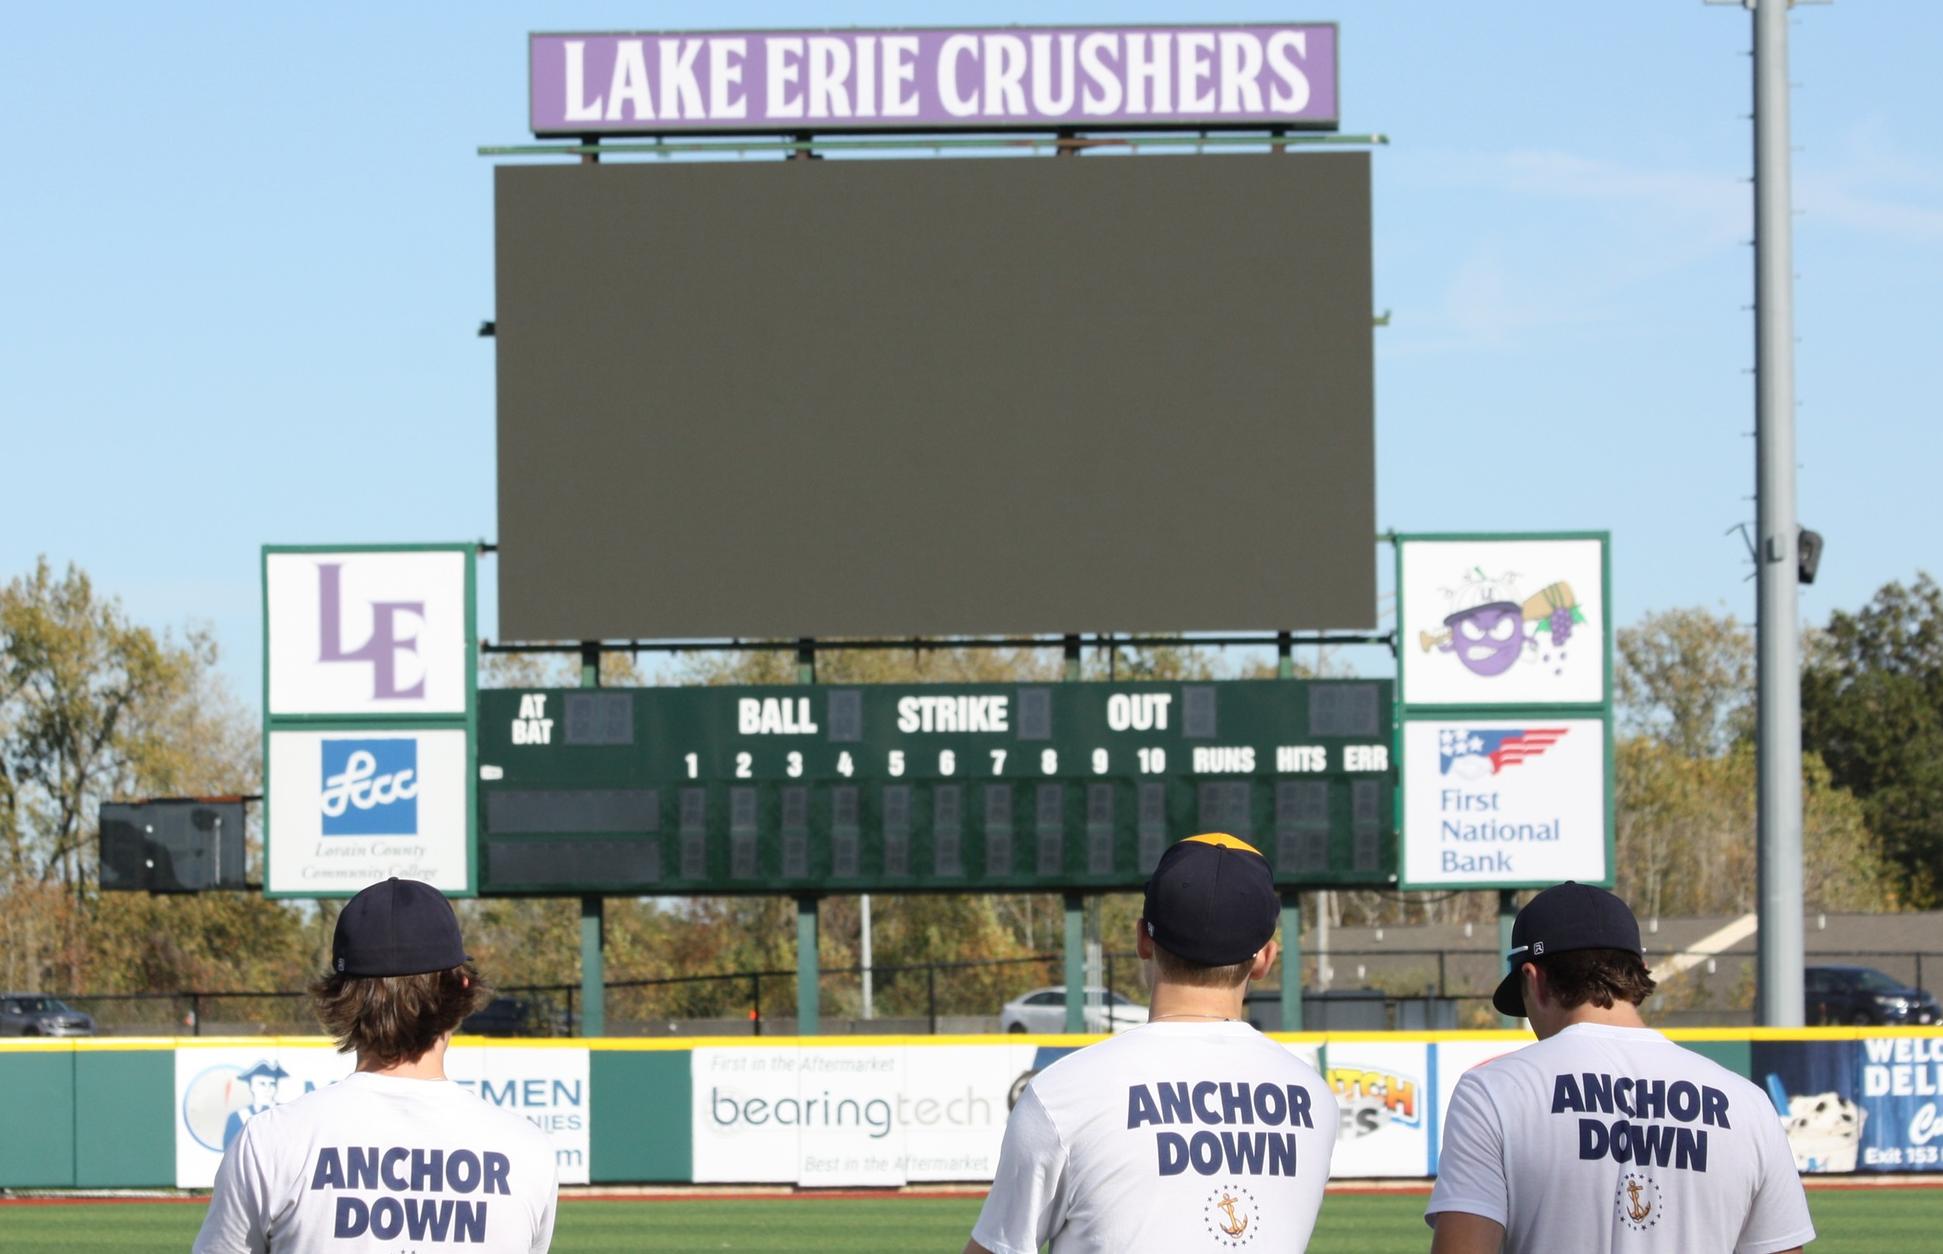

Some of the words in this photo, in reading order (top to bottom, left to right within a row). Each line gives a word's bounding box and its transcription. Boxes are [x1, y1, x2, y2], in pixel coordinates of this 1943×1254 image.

[564, 38, 748, 122] LAKE
[765, 36, 920, 119] ERIE
[937, 31, 1312, 118] CRUSHERS
[312, 562, 427, 700] LE
[518, 694, 547, 719] AT
[738, 697, 818, 735] BALL
[897, 695, 1009, 734] STRIKE
[1106, 693, 1172, 731] OUT
[511, 718, 553, 745] BAT
[684, 751, 699, 779] 1
[735, 751, 753, 779] 2
[786, 750, 803, 778] 3
[836, 750, 854, 778] 4
[888, 749, 905, 777] 5
[938, 748, 956, 776] 6
[990, 748, 1008, 775] 7
[1041, 748, 1058, 775] 8
[1091, 747, 1109, 775] 9
[1137, 747, 1166, 774] 10
[1193, 746, 1256, 774] RUNS
[1276, 745, 1327, 773] HITS
[1343, 744, 1388, 772] ERR
[1441, 788, 1500, 812] First
[1441, 818, 1560, 842] National
[370, 841, 426, 860] County
[1441, 850, 1513, 874] Bank
[301, 864, 384, 881] Community
[710, 1055, 747, 1072] First
[752, 1056, 767, 1072] in
[771, 1055, 796, 1072] the
[800, 1055, 896, 1073] Aftermarket
[1127, 1081, 1315, 1129] ANCHOR
[1551, 1073, 1731, 1129] ANCHOR
[1156, 1130, 1297, 1178] DOWN
[1578, 1118, 1708, 1173] DOWN
[1864, 1147, 1903, 1165] Exit
[1905, 1145, 1939, 1164] 153
[311, 1146, 512, 1196] ANCHOR
[804, 1155, 840, 1173] Best
[845, 1156, 860, 1173] in
[863, 1155, 889, 1172] the
[894, 1154, 989, 1172] Aftermarket
[333, 1196, 488, 1243] DOWN
